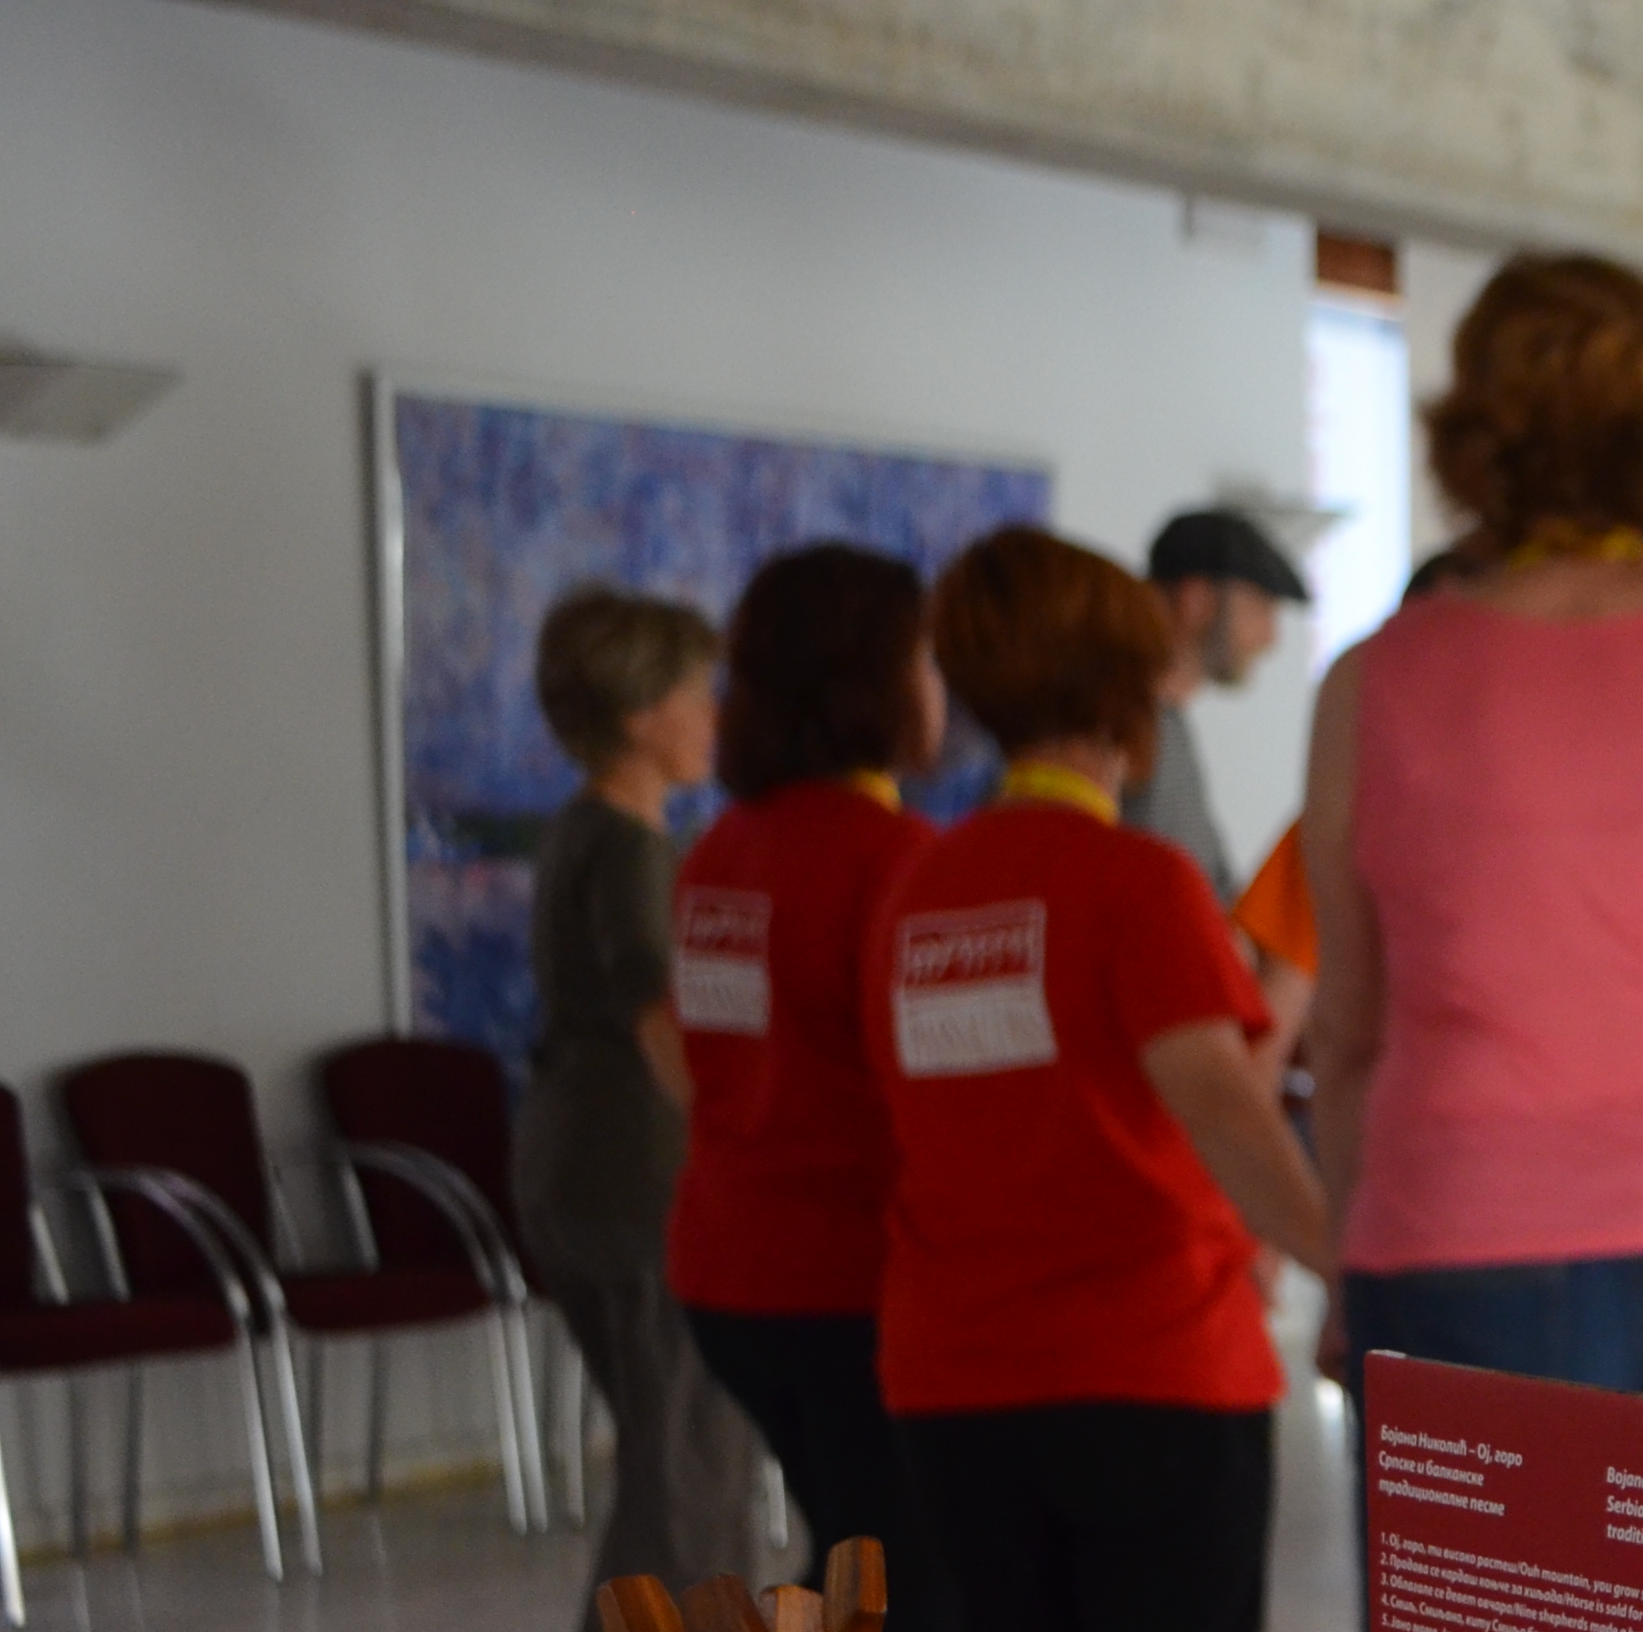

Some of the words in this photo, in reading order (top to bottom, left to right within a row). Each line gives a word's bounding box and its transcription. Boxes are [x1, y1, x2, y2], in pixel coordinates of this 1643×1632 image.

[1380, 1424, 1418, 1447] Бојана
[1417, 1432, 1468, 1456] Николић
[1378, 1450, 1416, 1473] Српске
[1416, 1461, 1425, 1475] и
[1425, 1459, 1485, 1487] балканске
[1378, 1478, 1469, 1509] традиционалне
[1469, 1497, 1505, 1517] песме
[1540, 1569, 1592, 1591] mountain,
[1592, 1580, 1613, 1594] you
[1613, 1583, 1641, 1599] grow
[1538, 1608, 1589, 1632] shepherds
[1595, 1599, 1605, 1614] is
[1605, 1602, 1628, 1618] sold
